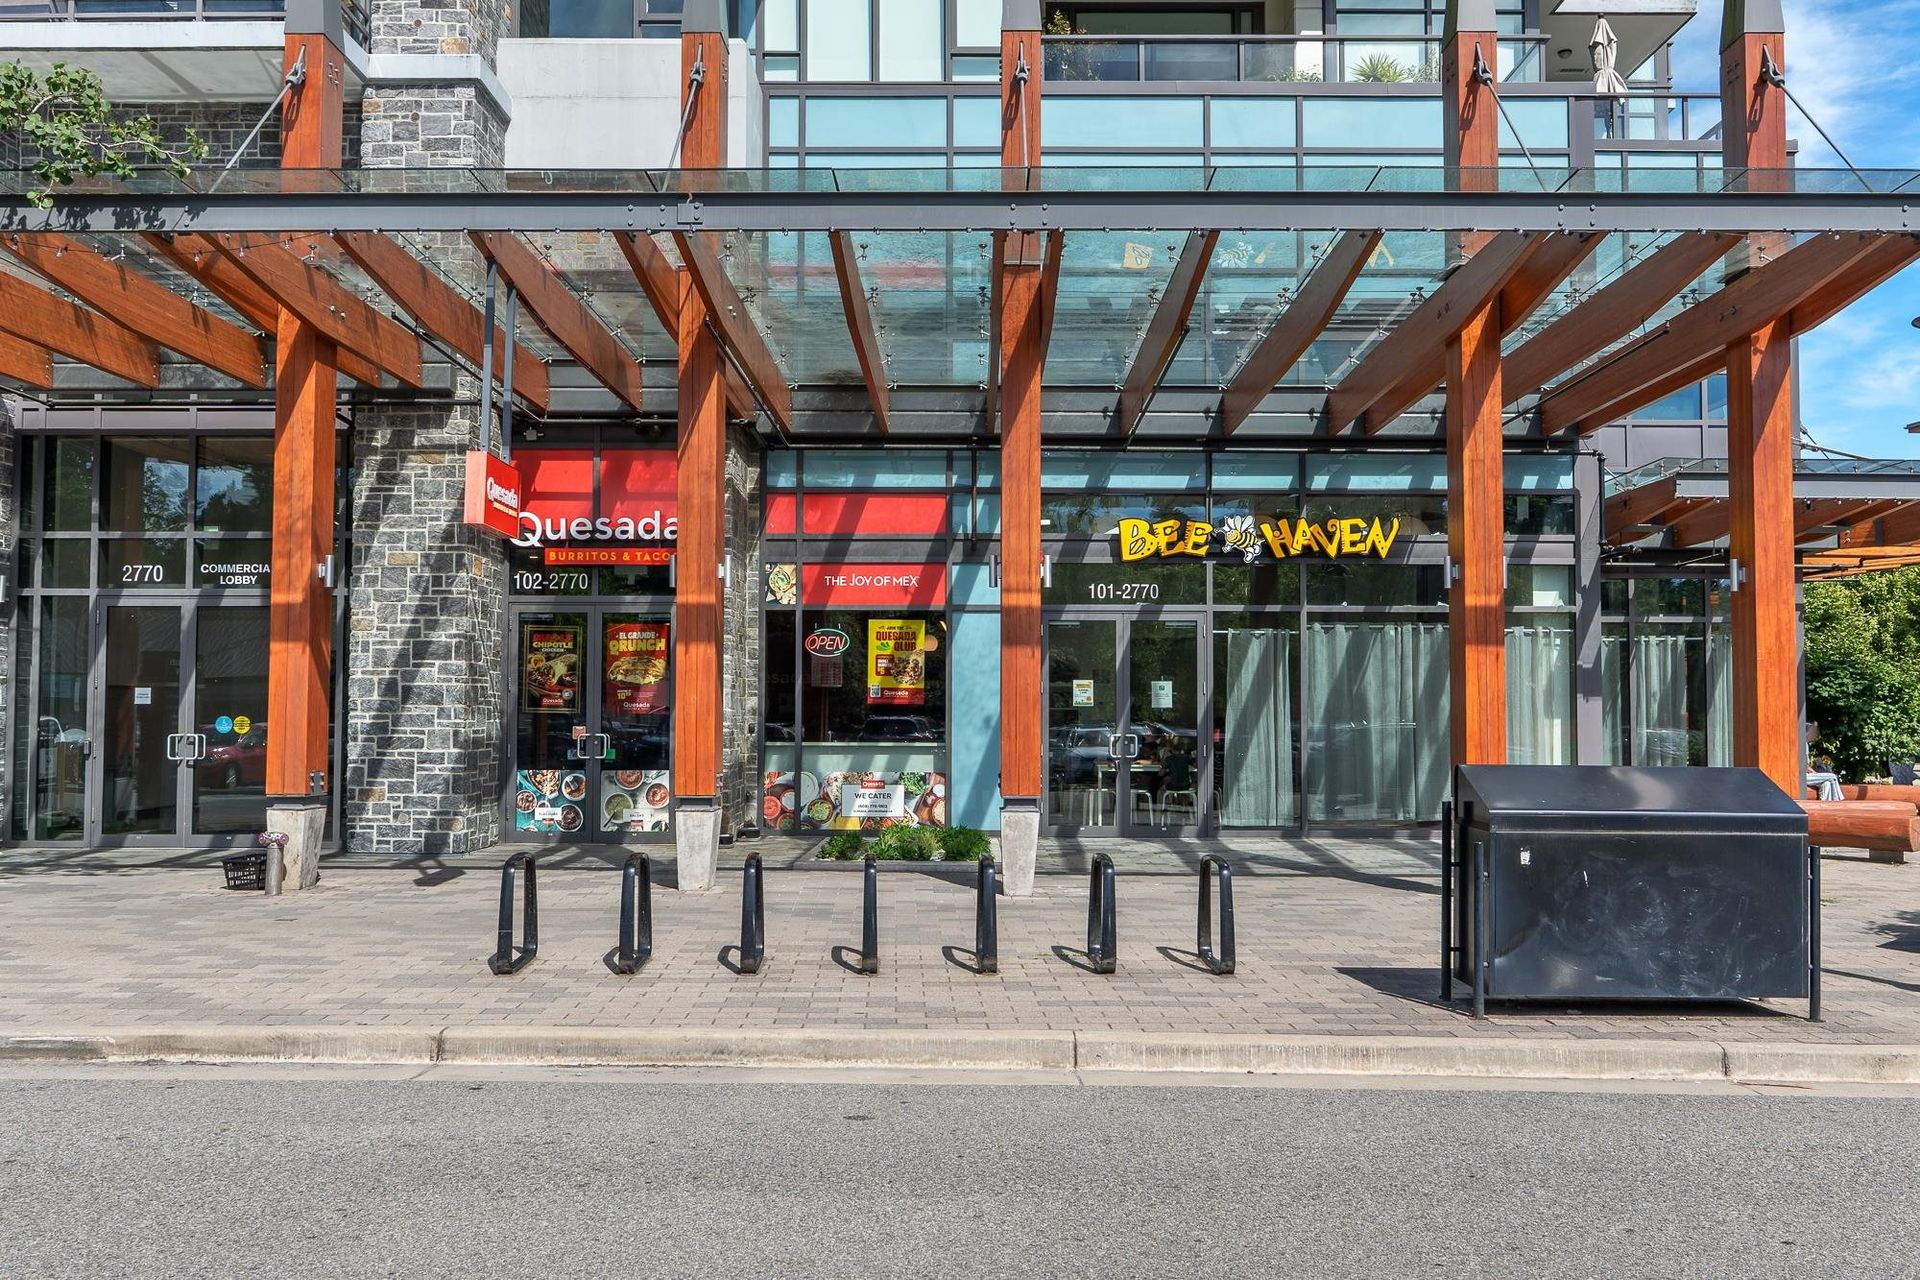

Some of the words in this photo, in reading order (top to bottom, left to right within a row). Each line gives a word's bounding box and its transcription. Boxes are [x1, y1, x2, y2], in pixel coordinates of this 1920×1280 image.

[509, 510, 678, 548] Quesada
[1117, 516, 1214, 562] BEE
[1259, 516, 1400, 560] HAVEN
[549, 551, 617, 561] BURRITOS
[622, 551, 631, 561] &
[635, 551, 674, 561] TACO
[122, 564, 164, 582] 2770
[200, 563, 271, 574] COMMERCIA
[220, 575, 258, 585] LOBBY
[513, 572, 589, 590] 102-2770
[824, 575, 847, 586] THE
[849, 573, 872, 587] JOY
[873, 575, 891, 586] OF
[1088, 583, 1159, 600] 101-2770
[628, 631, 656, 640] GRANDE
[876, 631, 917, 641] QUESADA
[532, 641, 574, 649] CHIPOTLE
[807, 636, 846, 651] OPEN
[854, 792, 867, 800] WE
[868, 792, 892, 800] CATER
